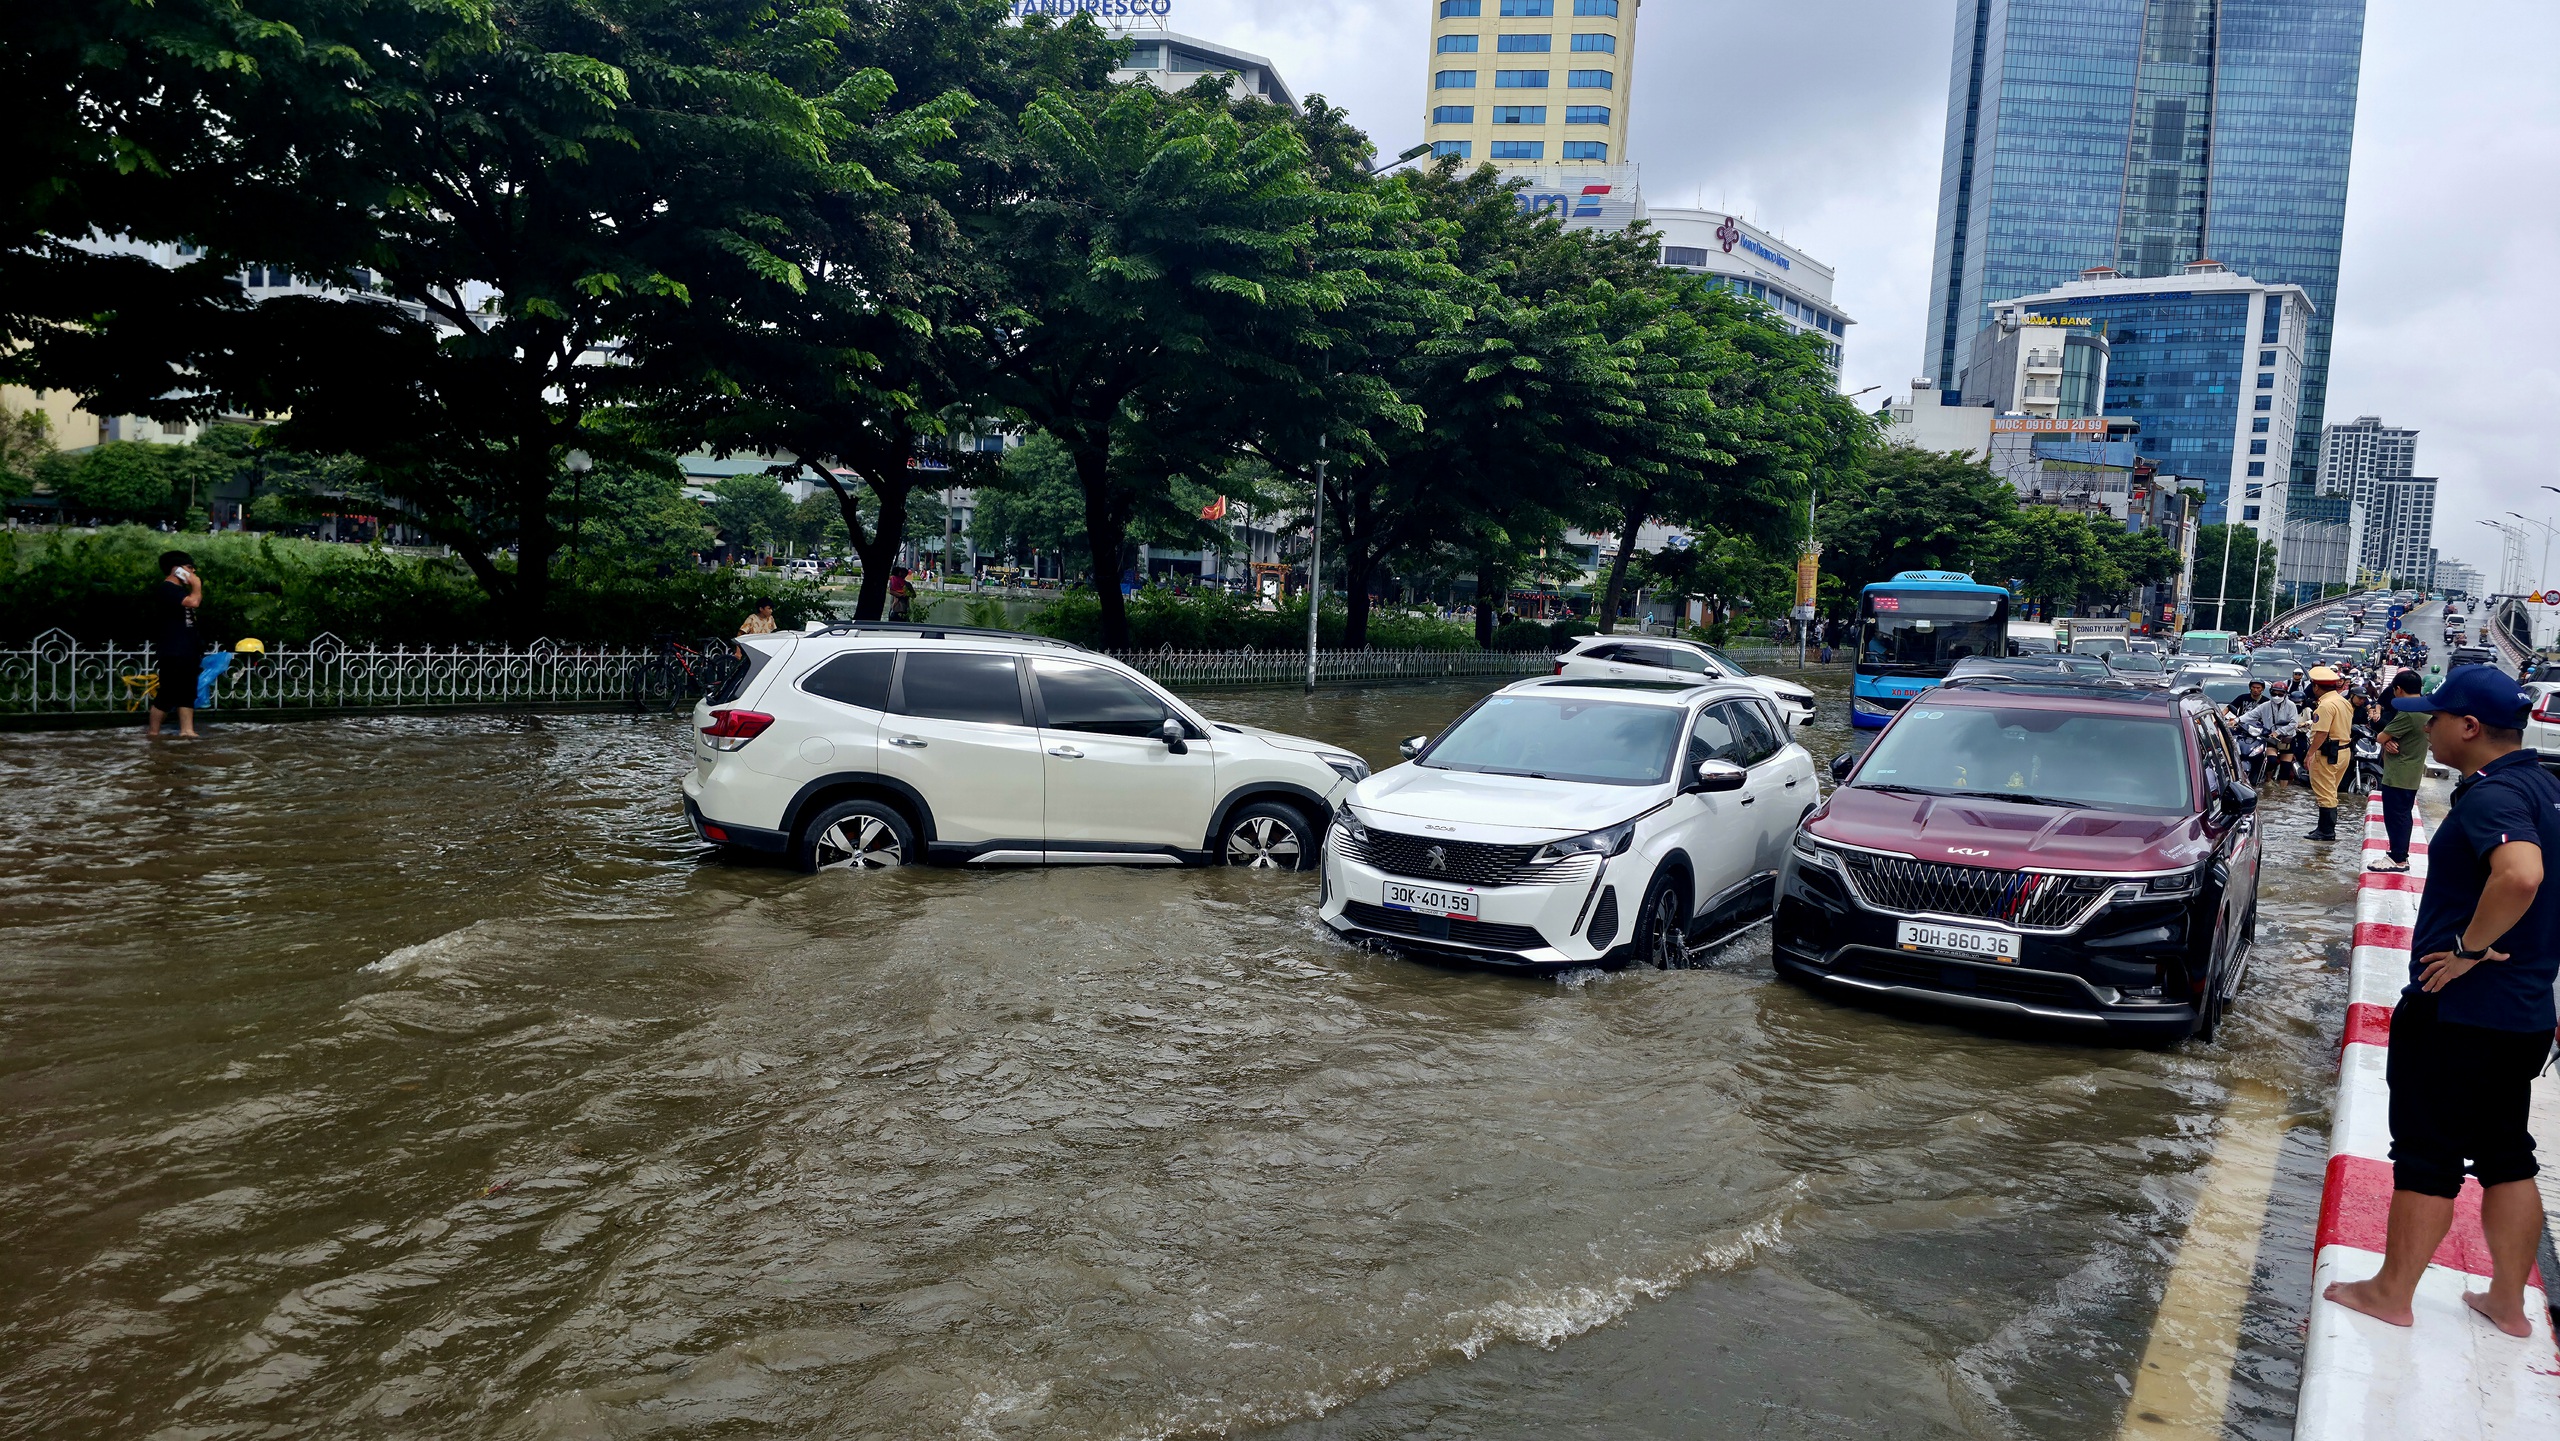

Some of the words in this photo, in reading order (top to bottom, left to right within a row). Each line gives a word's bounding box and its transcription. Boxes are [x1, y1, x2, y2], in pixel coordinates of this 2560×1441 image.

[2060, 317, 2093, 326] BANK
[1995, 420, 2023, 430] MQC:
[2026, 420, 2052, 430] 0916
[2055, 420, 2068, 430] 80
[2071, 420, 2085, 430] 20
[2088, 420, 2102, 430] 99
[1947, 846, 1990, 857] KIA
[1391, 886, 1469, 912] 30K-401.59
[1907, 927, 2009, 954] 30H-860.36
